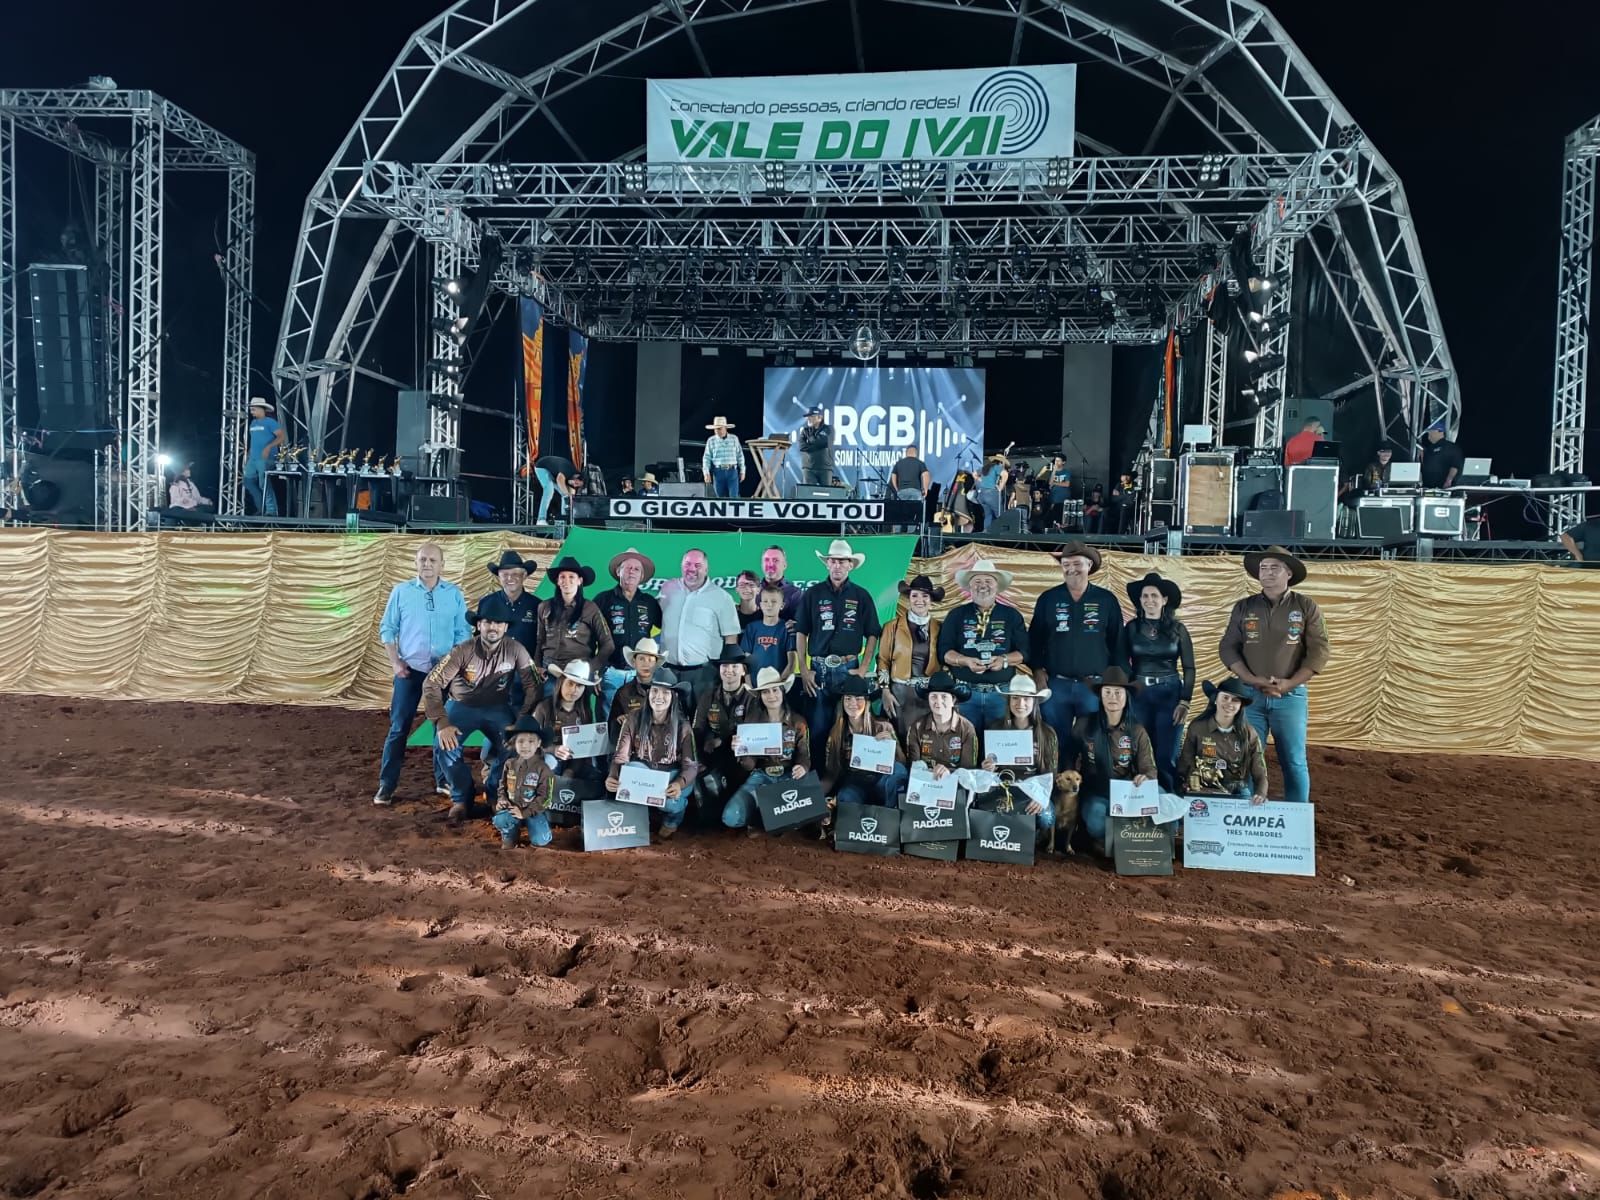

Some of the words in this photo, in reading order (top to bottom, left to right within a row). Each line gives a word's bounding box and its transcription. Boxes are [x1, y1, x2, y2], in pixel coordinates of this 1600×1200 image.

[670, 98, 765, 114] Conectando
[769, 100, 841, 116] pessoas,
[845, 97, 905, 112] criando
[910, 95, 961, 111] redes!
[670, 119, 804, 159] VALE
[814, 120, 890, 160] DO
[902, 115, 1005, 158] IVAI
[833, 405, 916, 447] RGB
[834, 450, 853, 466] SOM
[613, 501, 631, 516] O
[641, 501, 764, 517] GIGANTE
[774, 503, 883, 520] VOLTOU
[913, 818, 953, 829] RADADE
[1223, 814, 1286, 829] CAMPEÃ
[848, 831, 887, 844] RADADE
[1244, 830, 1283, 838] TAMBORES
[980, 839, 1021, 852] RADADE
[1233, 850, 1269, 858] CATEGORIA
[1270, 852, 1304, 861] FEMININO
